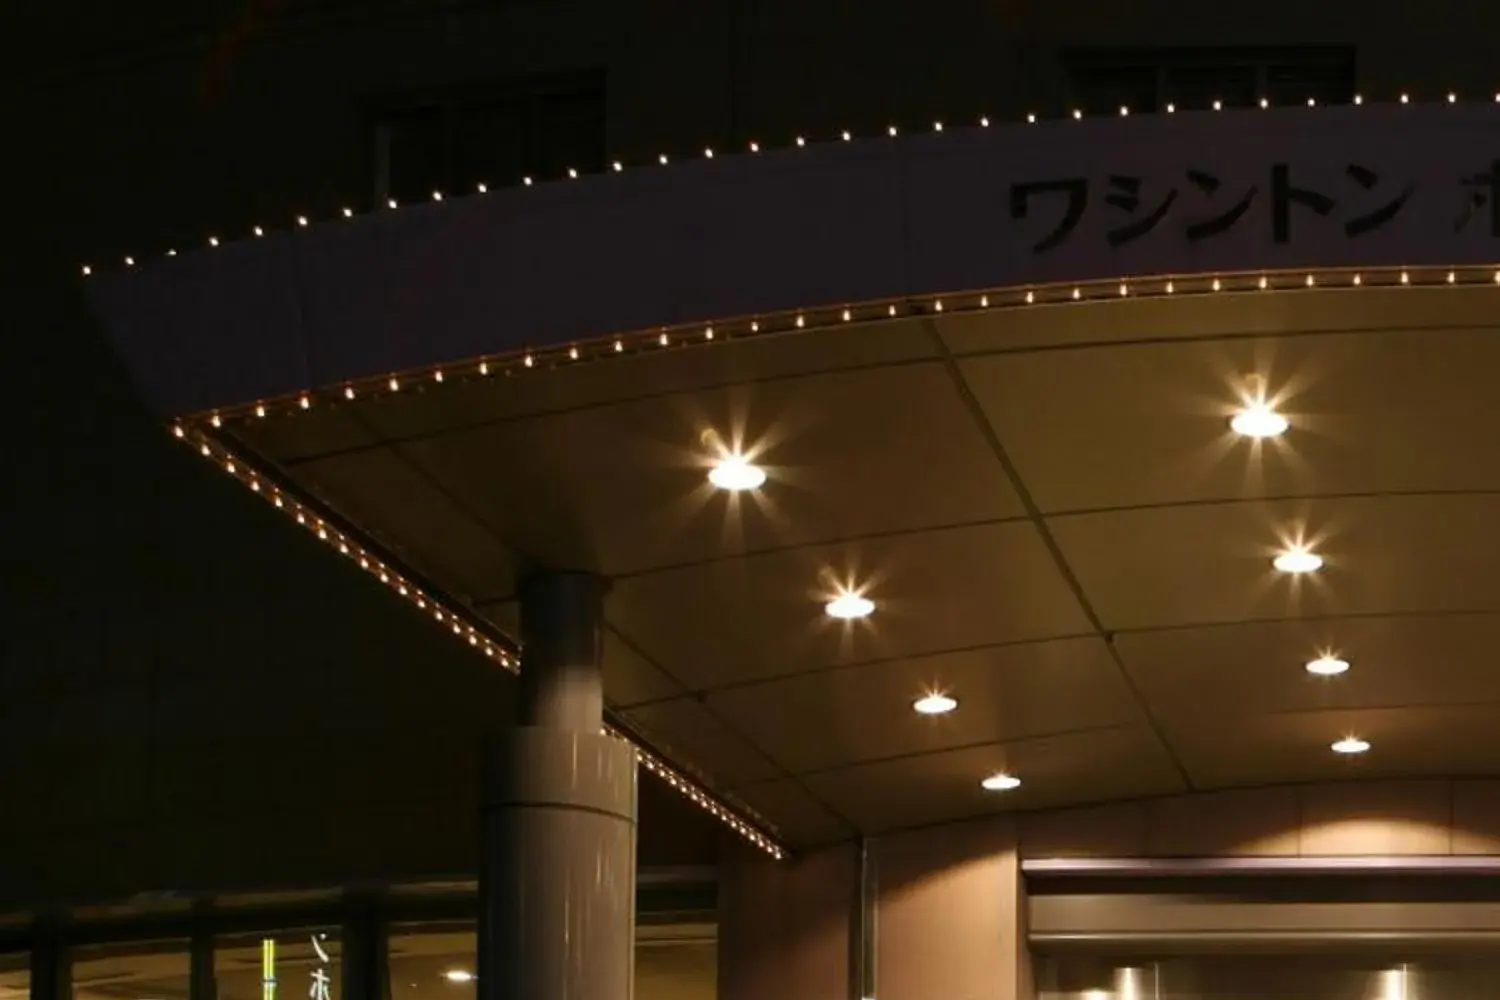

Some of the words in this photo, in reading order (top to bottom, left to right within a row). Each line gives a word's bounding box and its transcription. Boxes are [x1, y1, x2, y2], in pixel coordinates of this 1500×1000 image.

[1010, 162, 1414, 254] ワシントン
